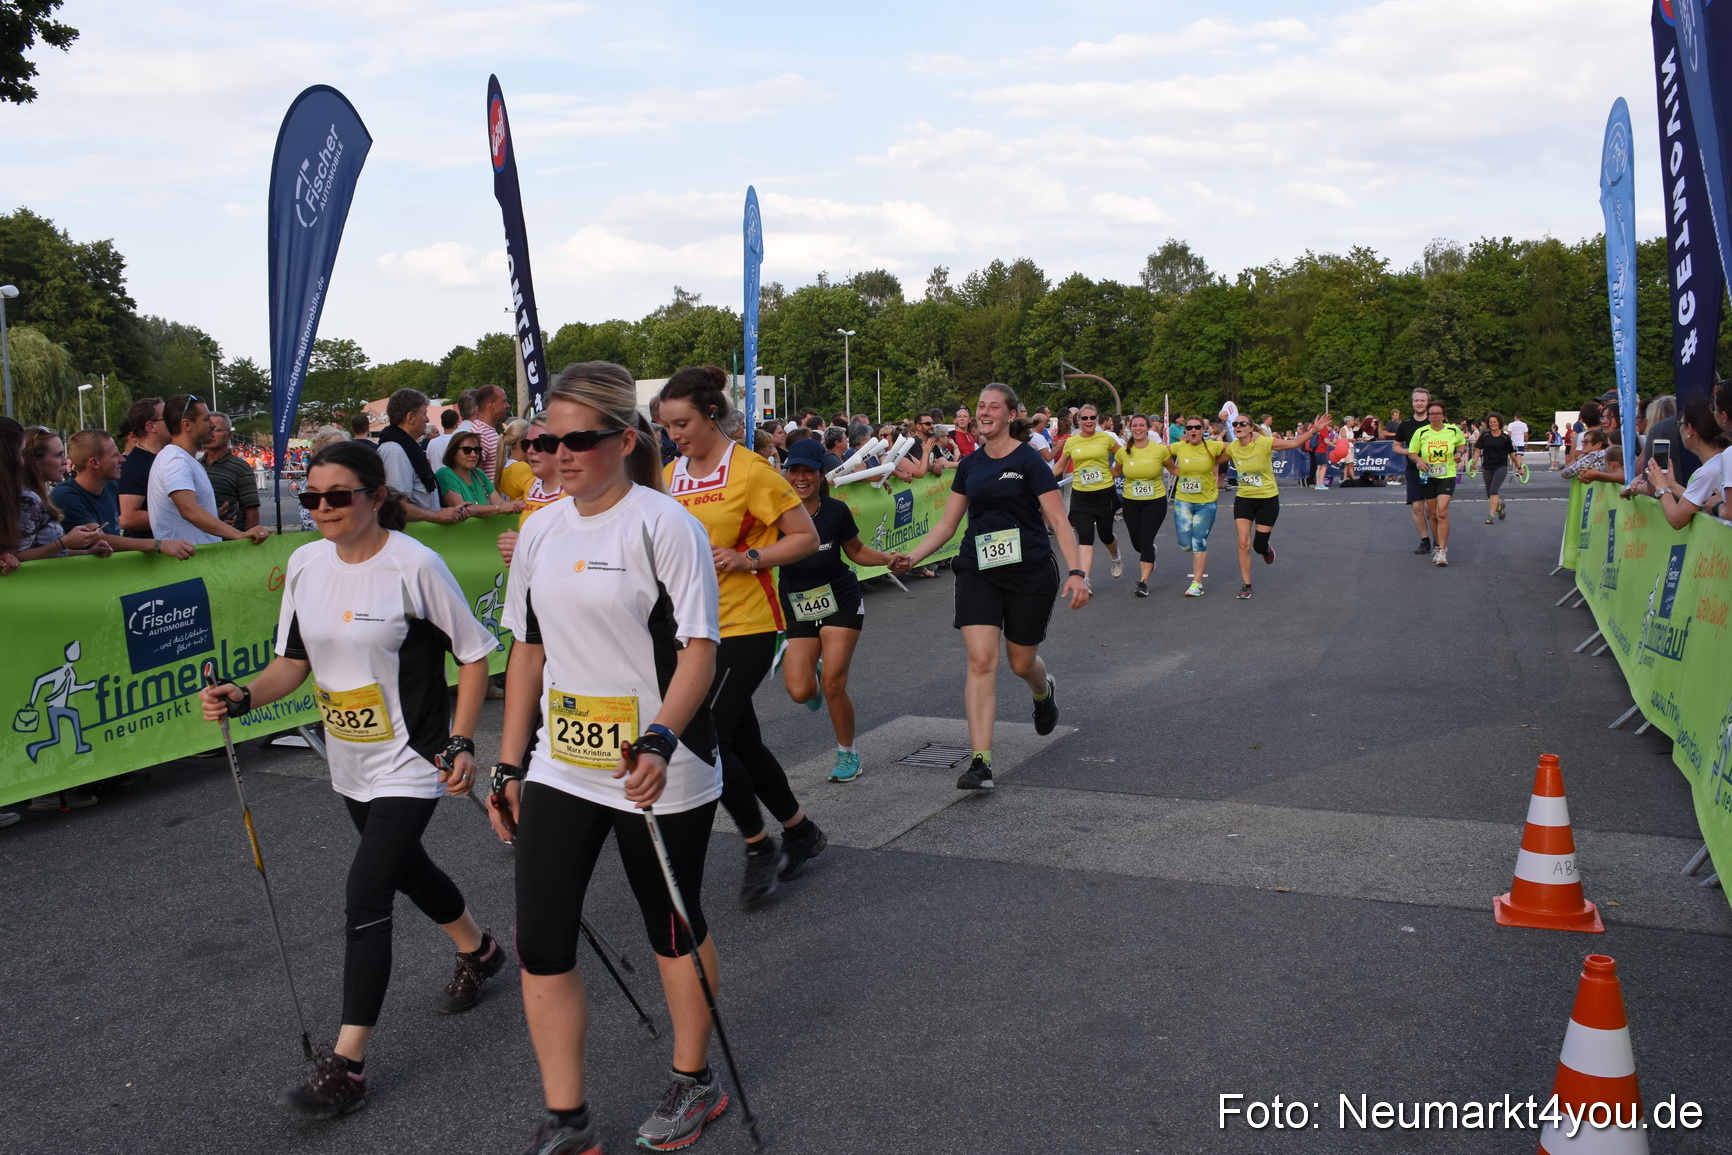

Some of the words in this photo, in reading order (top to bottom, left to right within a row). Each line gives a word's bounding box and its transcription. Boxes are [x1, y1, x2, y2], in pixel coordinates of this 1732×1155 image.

[305, 123, 338, 213] Fischer
[319, 140, 344, 212] AUTOMOBILE
[1082, 471, 1100, 481] 1203
[1243, 476, 1260, 484] 1235
[693, 492, 726, 506] BÖGL
[885, 512, 930, 550] firmenlauf
[981, 541, 1013, 559] 1381
[796, 597, 830, 613] 1440
[142, 605, 198, 630] Fischer
[148, 618, 195, 637] AUTOMOBILE
[104, 698, 192, 743] neumarkt
[322, 705, 377, 729] 2382
[556, 717, 620, 749] 2381
[566, 745, 582, 754] Marx
[582, 748, 612, 757] Kristina
